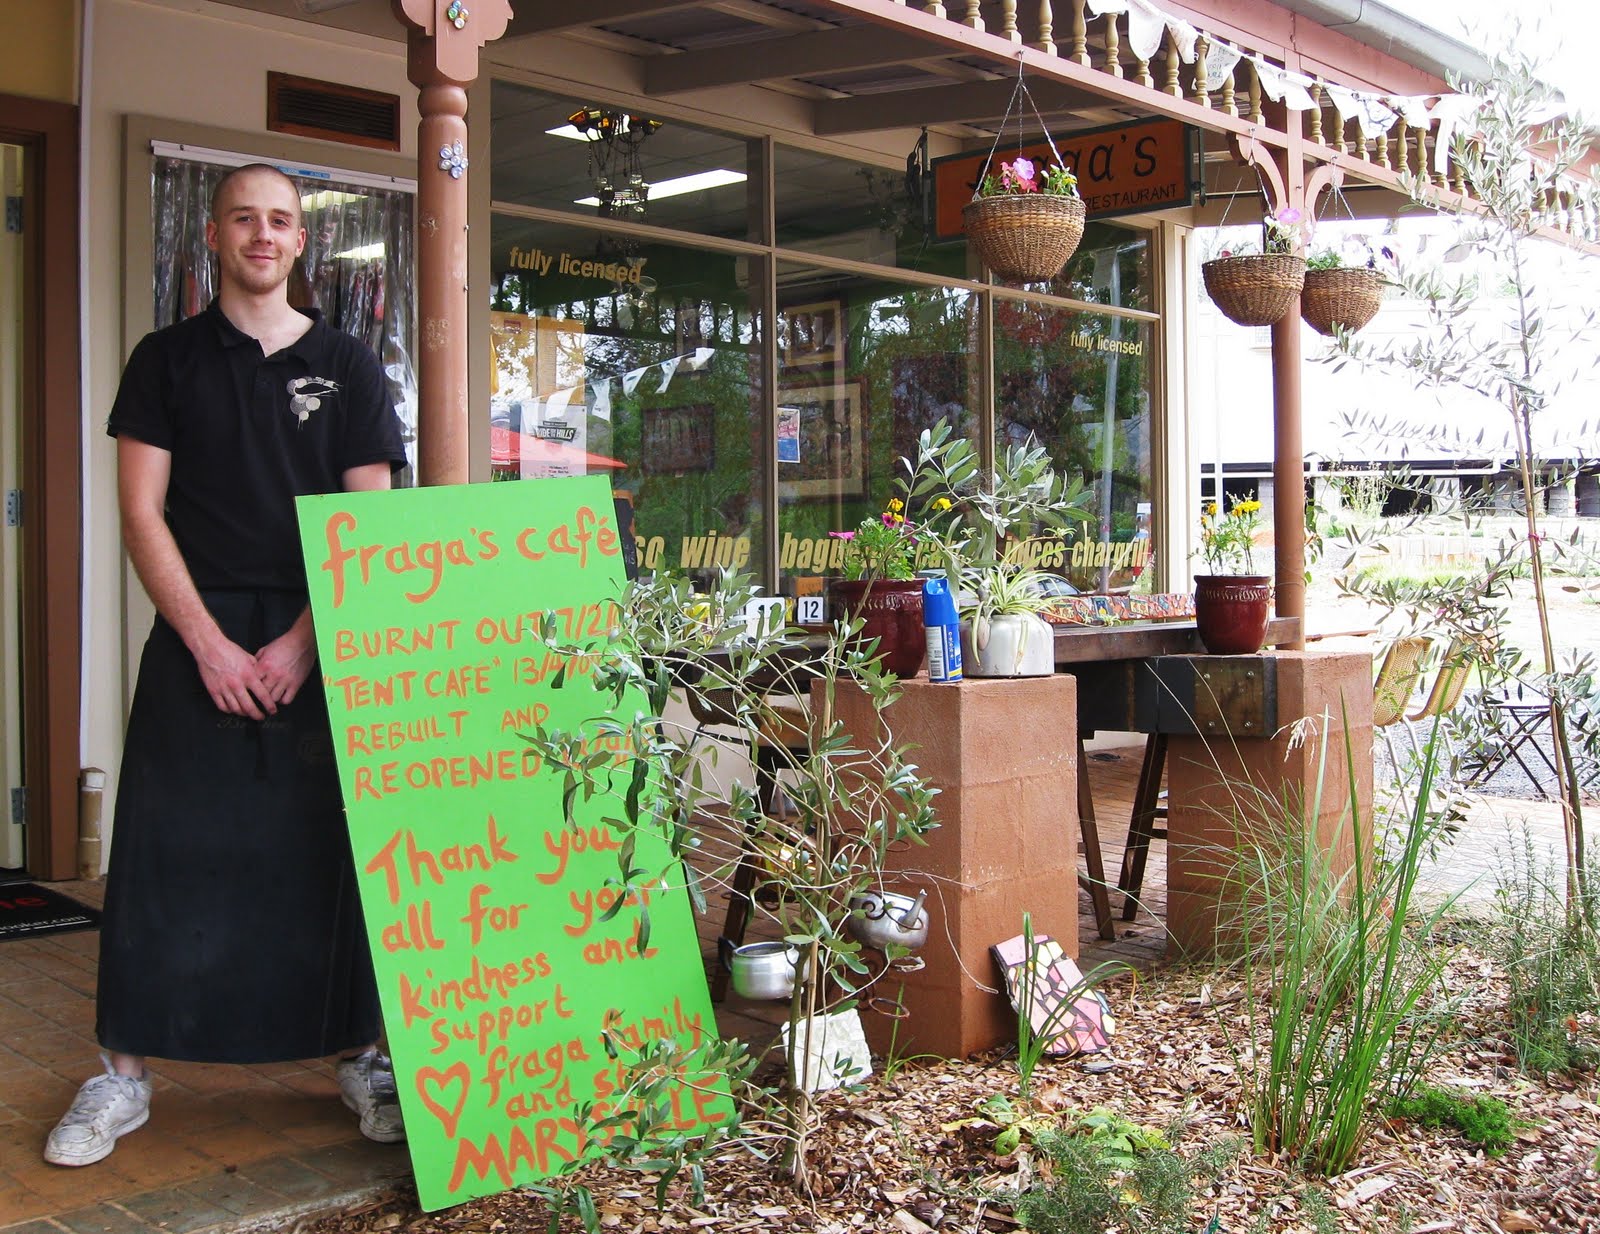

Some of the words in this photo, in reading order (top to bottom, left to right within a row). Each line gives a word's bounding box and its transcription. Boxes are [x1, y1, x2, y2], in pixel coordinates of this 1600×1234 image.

[1085, 183, 1177, 211] RESTAURANT
[509, 246, 553, 277] fully
[558, 252, 642, 284] licensed
[1070, 330, 1095, 352] fully
[1097, 334, 1143, 356] licensed
[556, 428, 574, 440] HILLS
[322, 511, 500, 609] fraga's
[515, 506, 621, 569] café
[680, 529, 751, 569] wine
[1071, 536, 1151, 571] chargrill
[335, 619, 461, 663] BURNT
[475, 610, 544, 645] OUT
[803, 600, 820, 619] 12
[346, 710, 469, 757] REBUILT
[500, 702, 549, 732] AND
[355, 746, 541, 801] REOPENED
[365, 813, 519, 905] Thank
[535, 826, 624, 885] you
[381, 900, 445, 953] all
[461, 884, 530, 946] for
[400, 952, 552, 1029] kindness
[582, 916, 659, 966] and
[430, 984, 574, 1056] support
[480, 1038, 590, 1108] fraga
[504, 1078, 575, 1120] and
